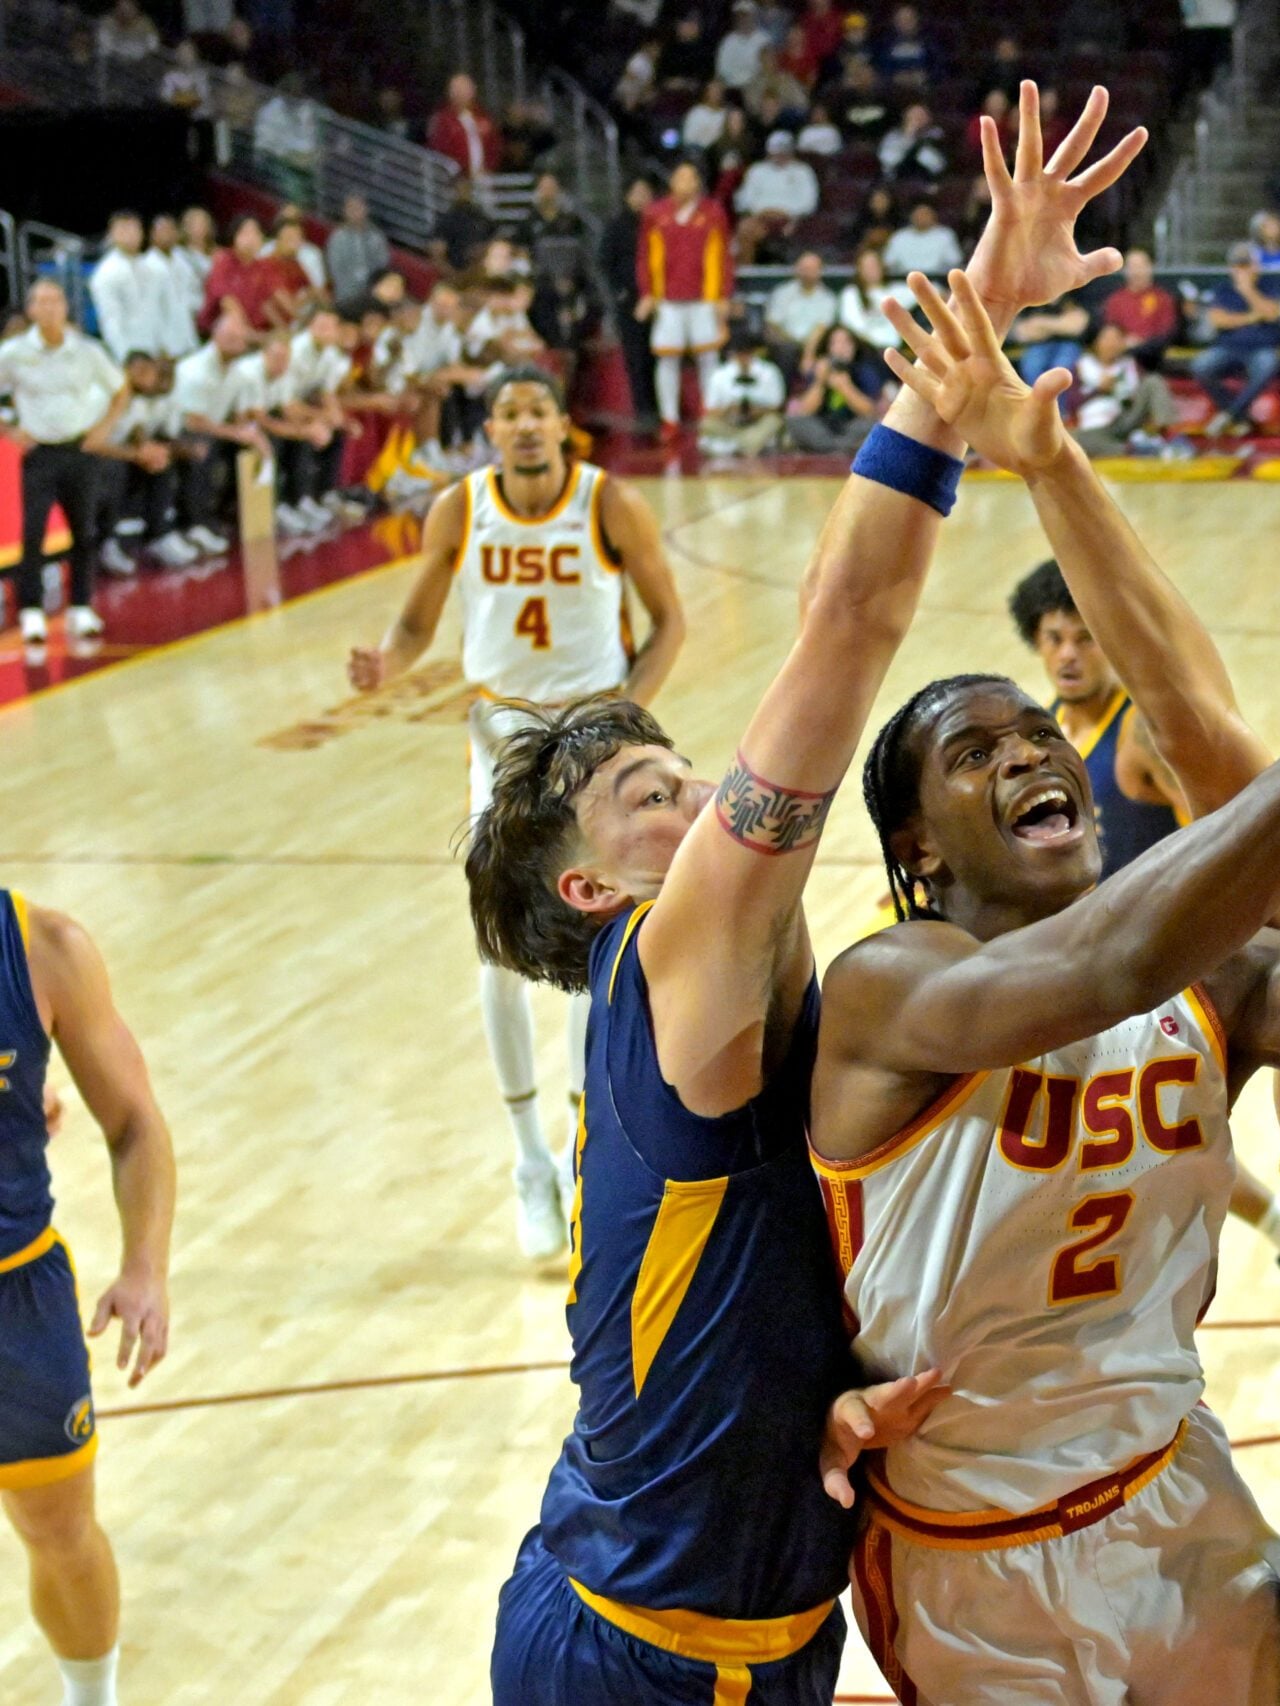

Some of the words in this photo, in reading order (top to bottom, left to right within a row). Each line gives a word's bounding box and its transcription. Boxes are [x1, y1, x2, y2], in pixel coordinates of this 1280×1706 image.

[480, 543, 582, 586] USC
[513, 596, 552, 651] 4
[996, 1053, 1206, 1176] USC
[1047, 1187, 1137, 1307] 2
[1066, 1484, 1120, 1519] TROJANS
